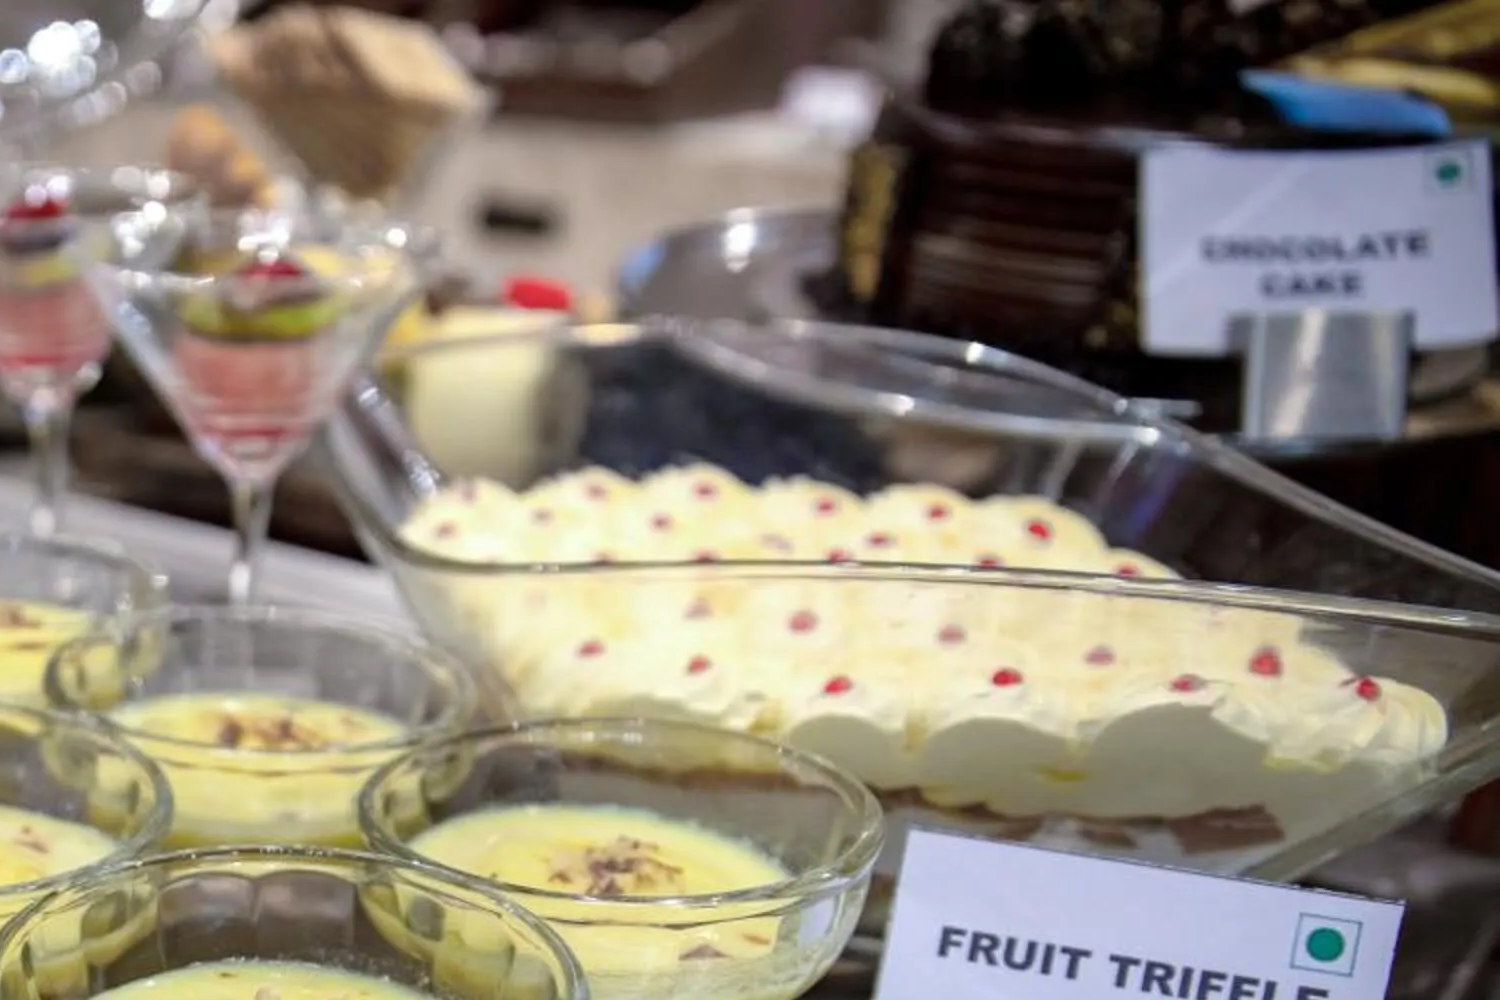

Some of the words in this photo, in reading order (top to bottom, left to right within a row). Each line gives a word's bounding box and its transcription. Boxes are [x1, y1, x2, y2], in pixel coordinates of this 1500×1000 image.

[1202, 229, 1430, 262] CHOCOLATE
[1261, 271, 1363, 297] CAKE
[937, 926, 1091, 979] FRUIT
